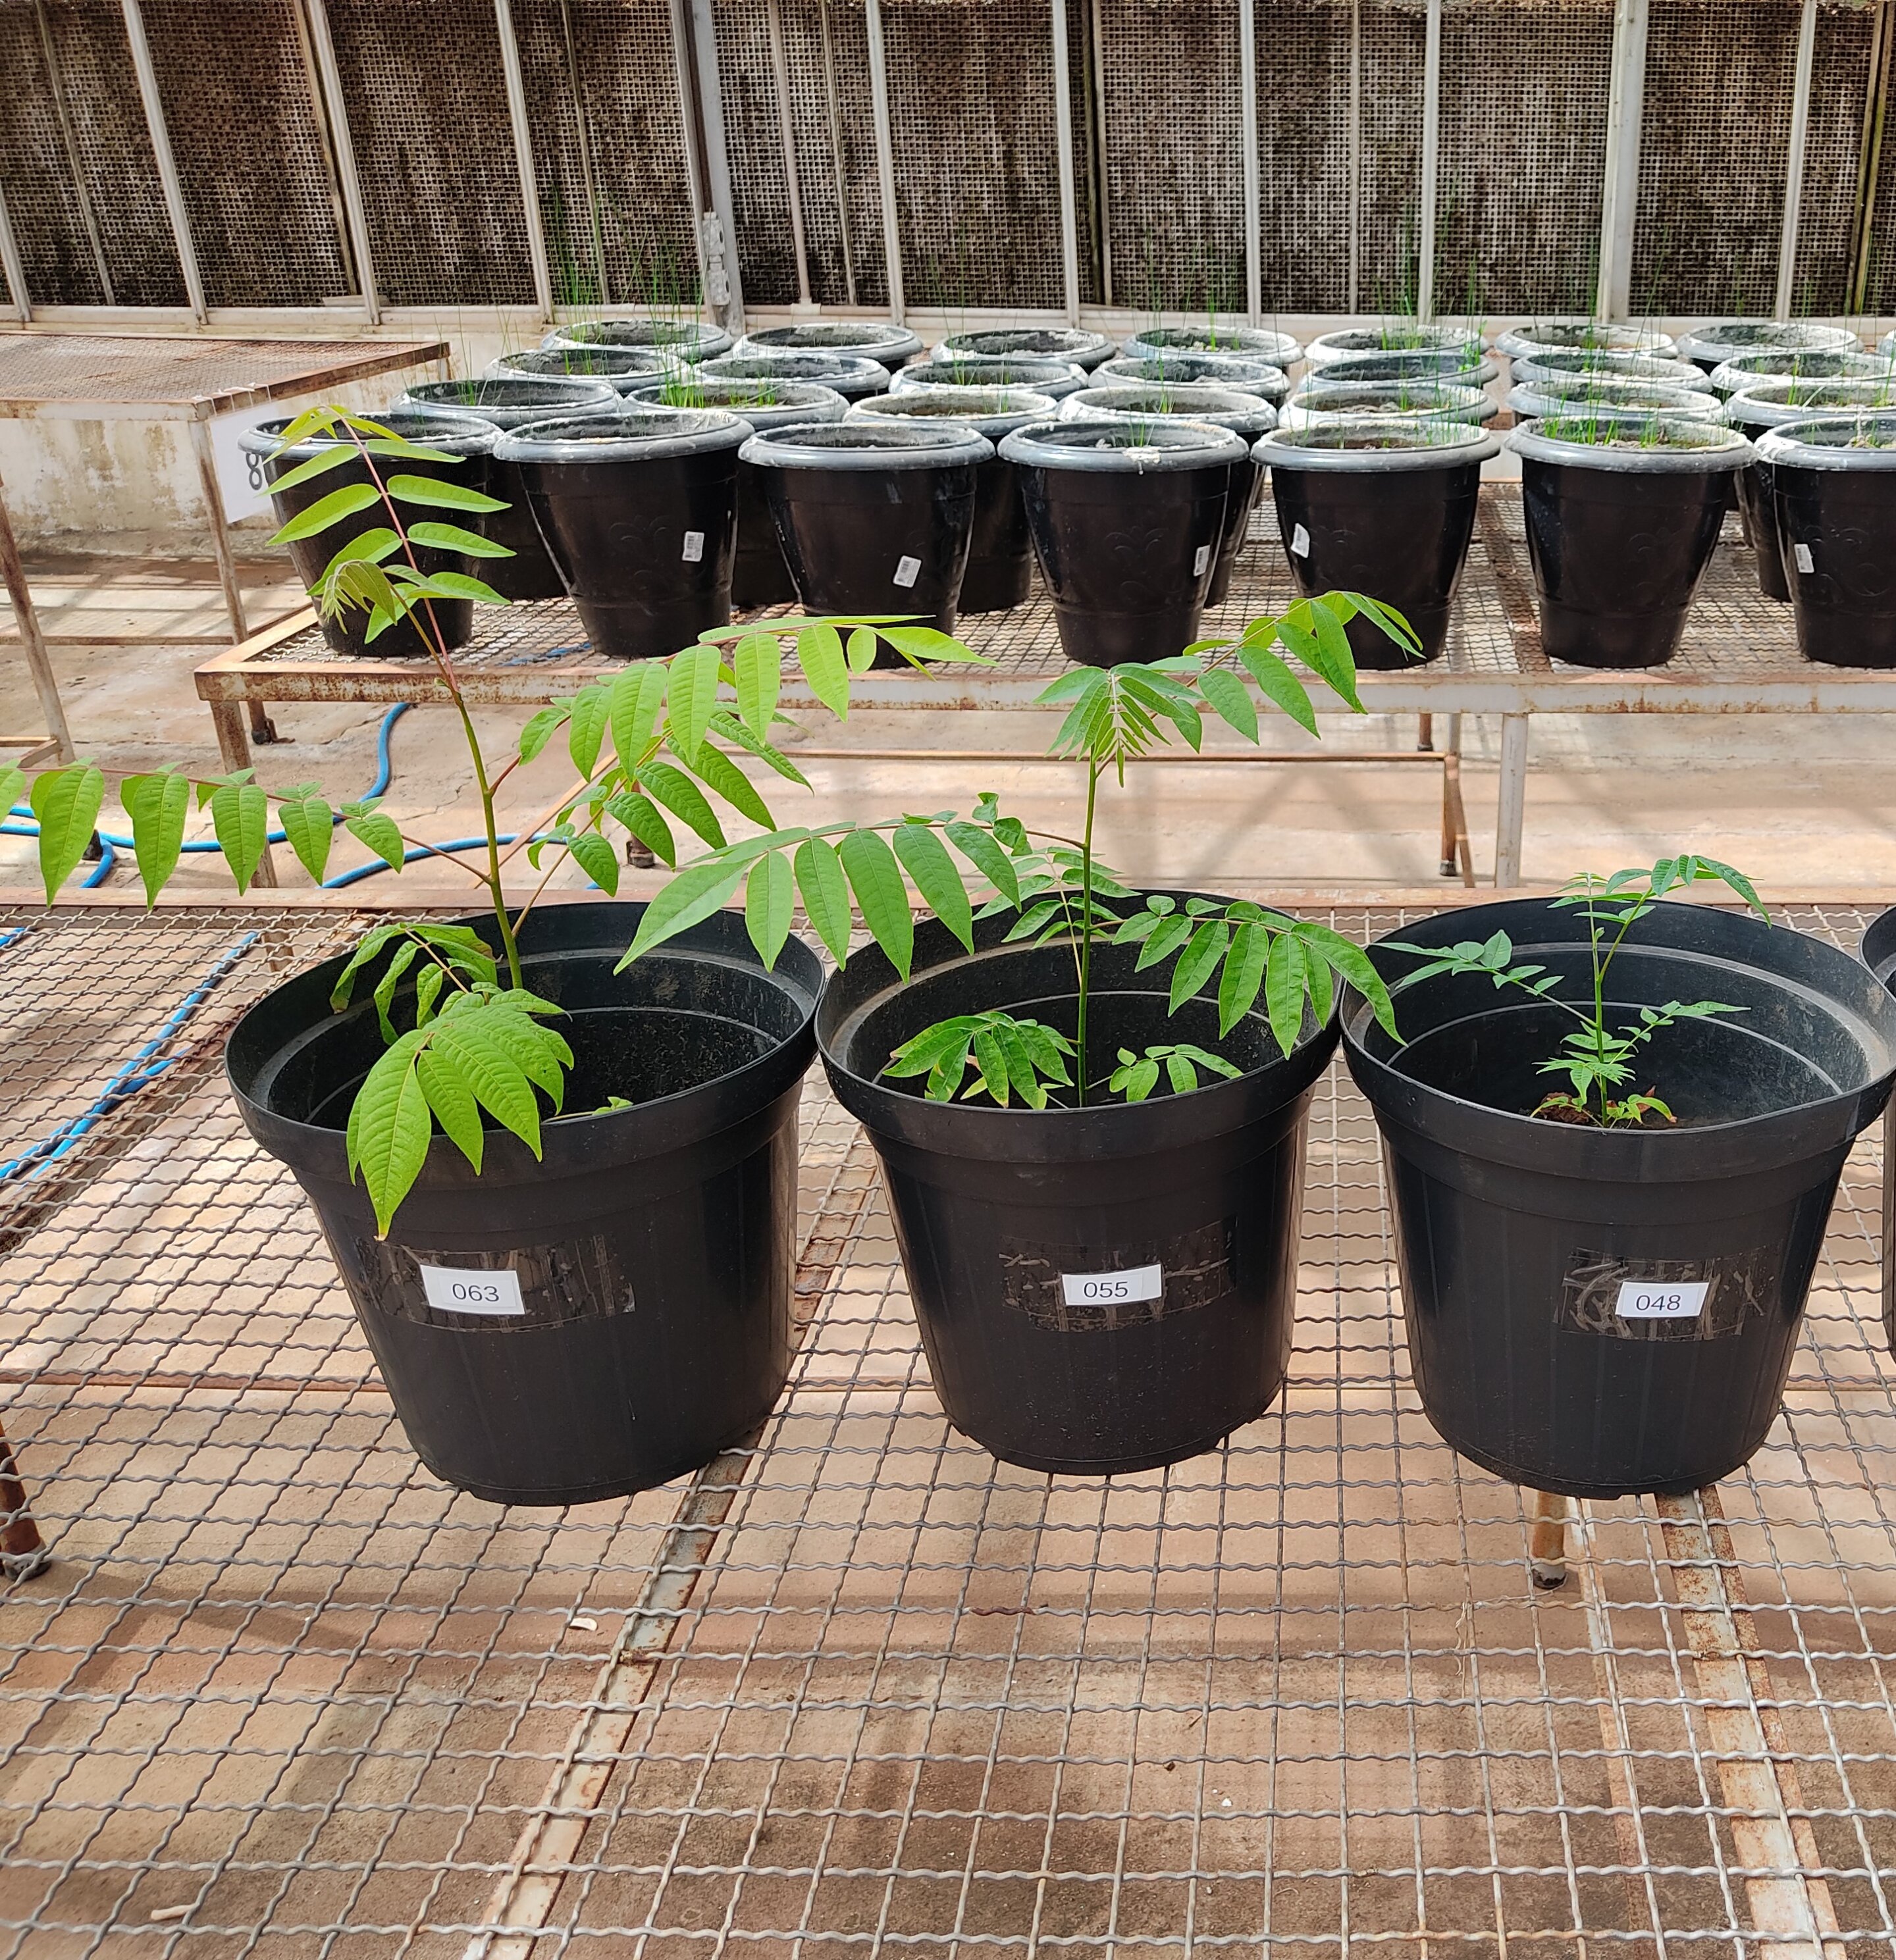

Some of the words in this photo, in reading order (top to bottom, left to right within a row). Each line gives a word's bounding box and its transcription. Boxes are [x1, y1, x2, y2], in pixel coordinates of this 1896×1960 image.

[452, 1283, 500, 1302] 063
[1083, 1281, 1129, 1299] 055
[1635, 1294, 1682, 1312] 048
